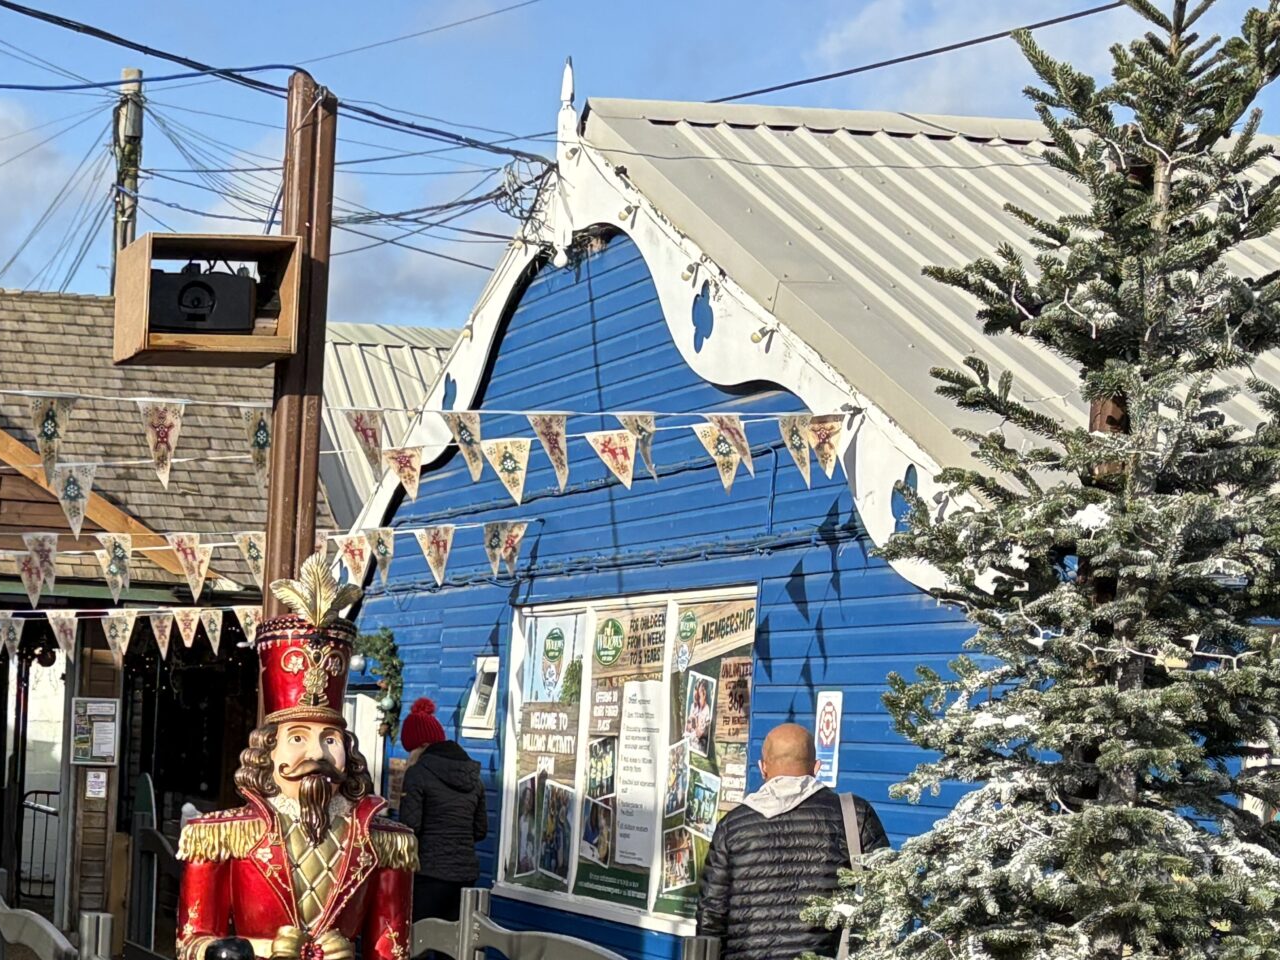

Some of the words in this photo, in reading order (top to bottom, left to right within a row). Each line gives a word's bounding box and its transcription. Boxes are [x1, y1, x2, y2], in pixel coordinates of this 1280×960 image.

[701, 608, 755, 643] MEMBERSHIP
[644, 647, 661, 664] YEARS
[530, 711, 557, 730] WELCOME
[558, 712, 568, 731] TO
[523, 733, 547, 753] WILLOWS
[547, 735, 576, 754] ACTIVITY
